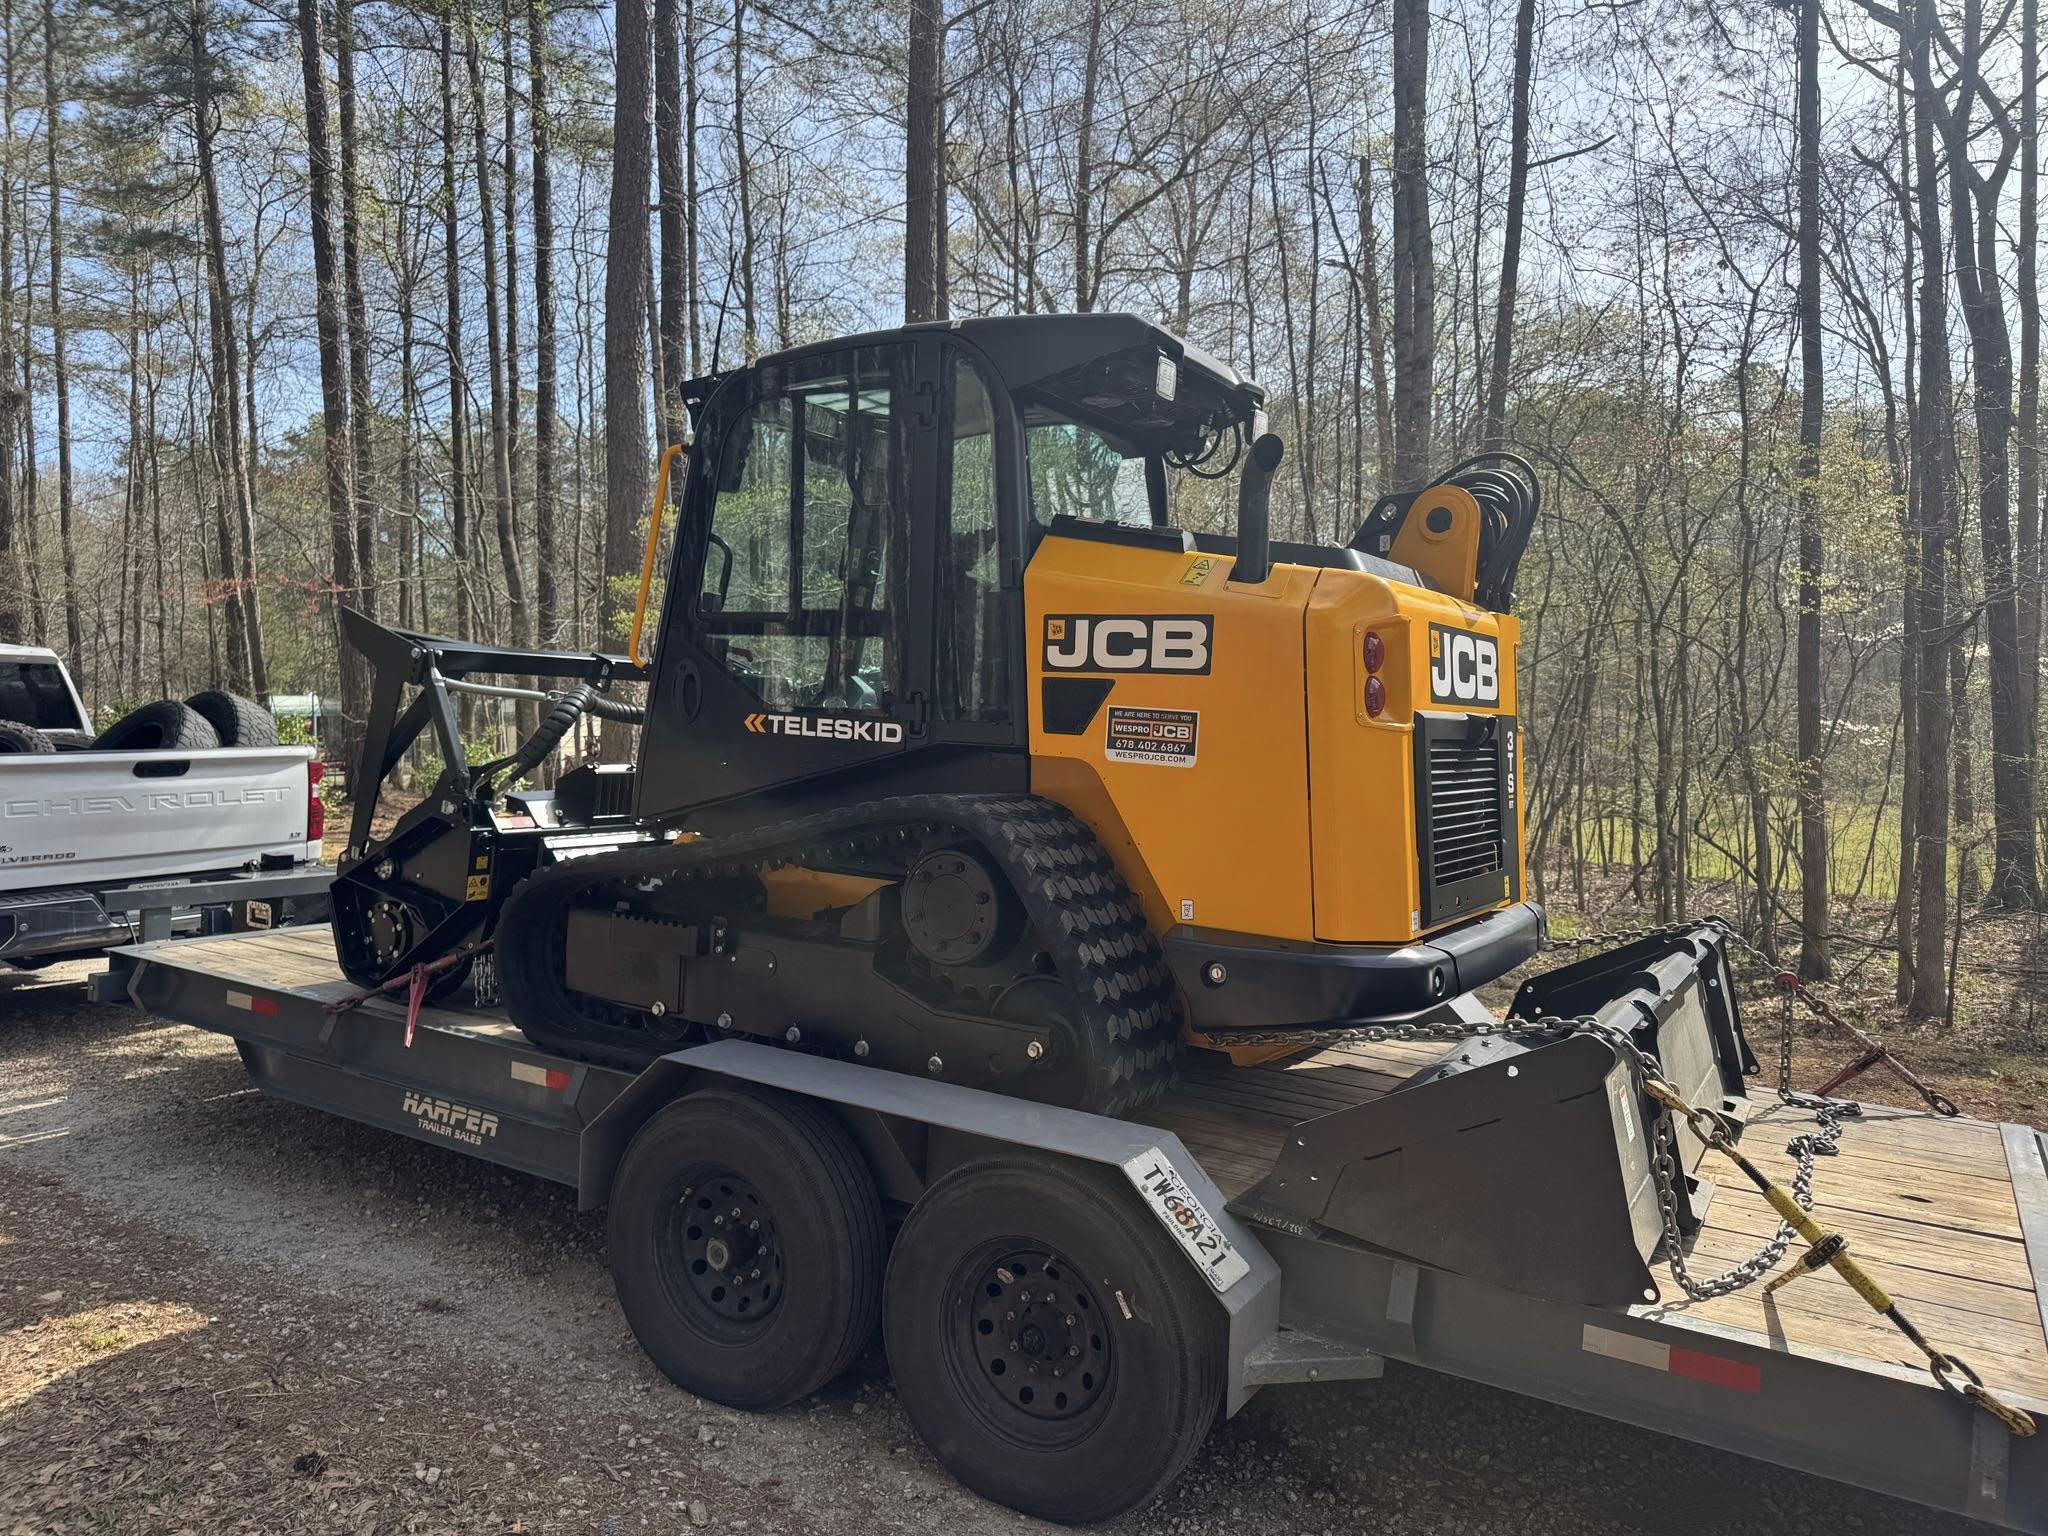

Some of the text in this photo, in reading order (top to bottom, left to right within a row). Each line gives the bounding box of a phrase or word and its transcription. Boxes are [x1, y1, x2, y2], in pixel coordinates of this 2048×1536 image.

[1047, 619, 1208, 670] JCB
[1431, 632, 1498, 701] JCB
[767, 714, 903, 743] TELESKID
[1114, 724, 1190, 739] WESPRO JCB
[1115, 739, 1186, 753] 678.402.6867
[1115, 751, 1186, 763] WESPROJCB.COM
[4, 786, 291, 819] CHEVROLET
[402, 1091, 499, 1137] HARPER
[418, 1118, 482, 1145] TRAILER SALES
[1144, 1163, 1227, 1267] TW68A21
[1162, 1211, 1186, 1239] PAULDING
[1171, 1175, 1223, 1244] GEORGIA
